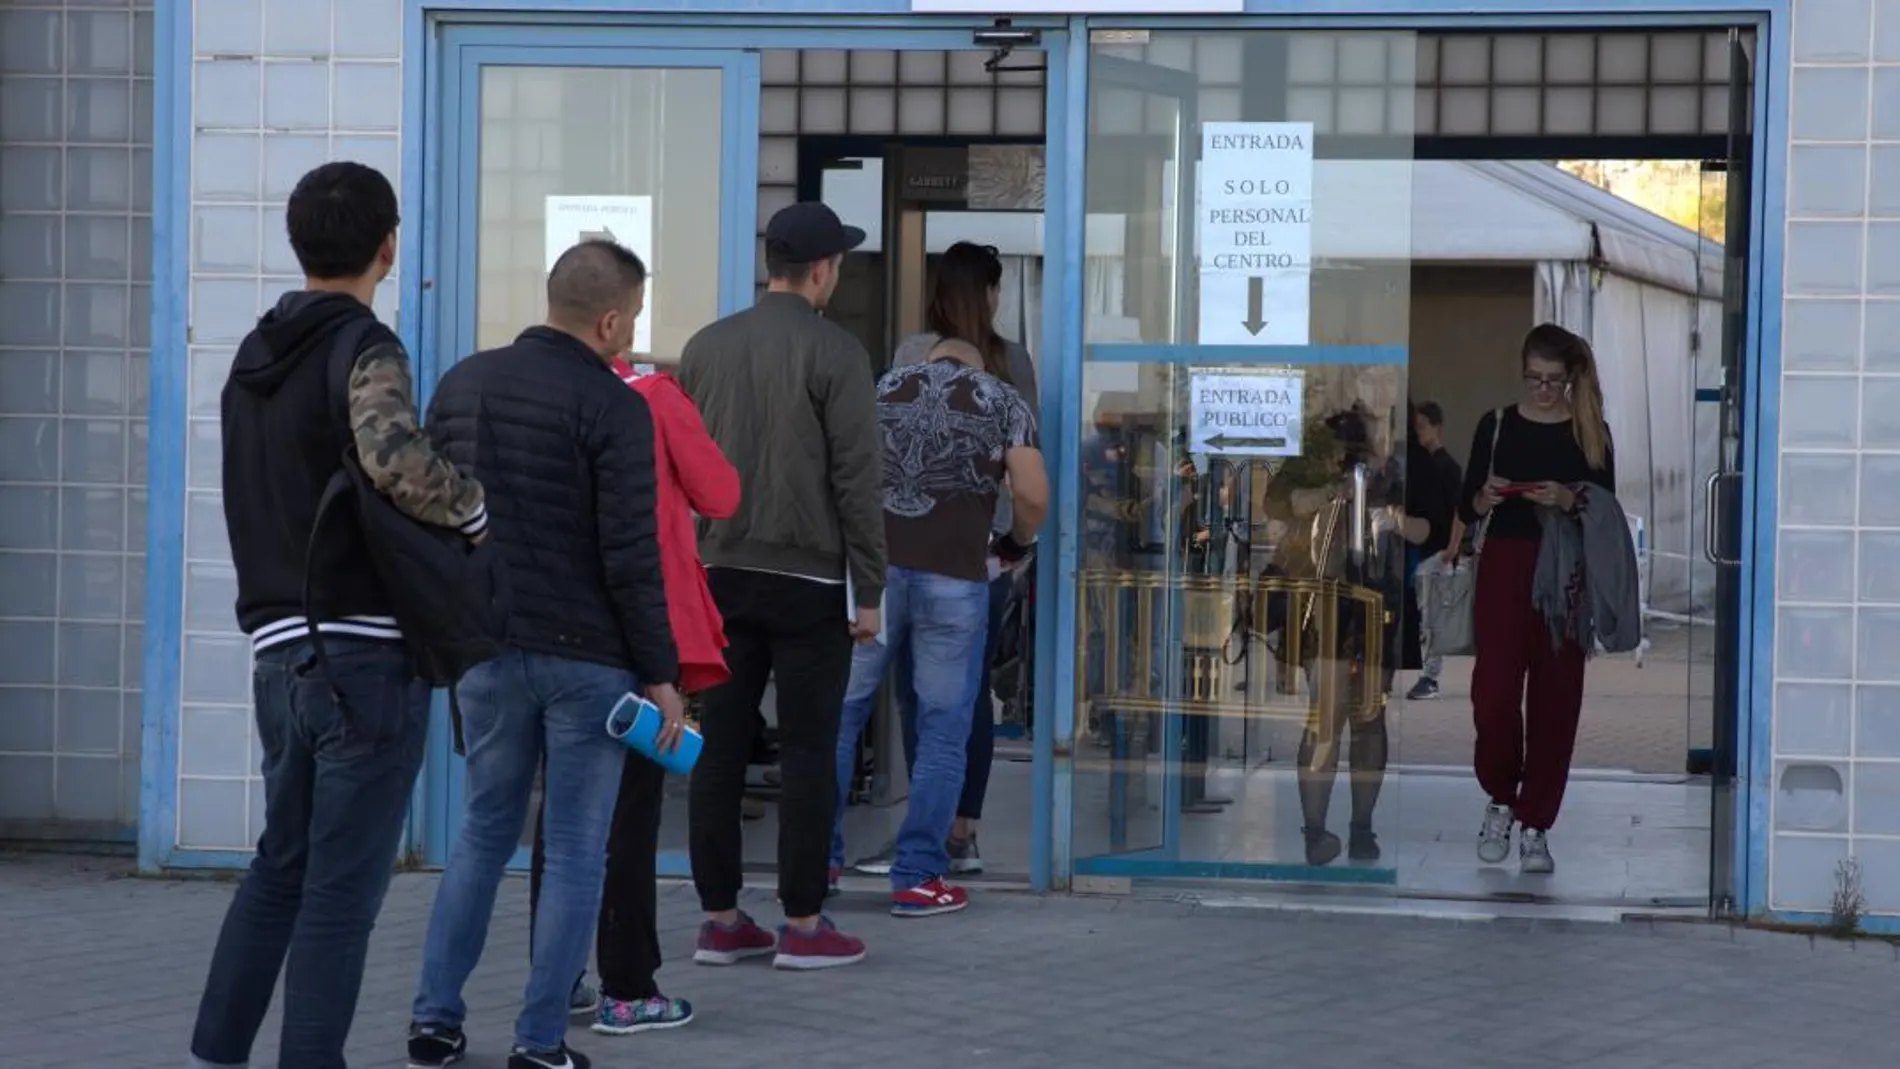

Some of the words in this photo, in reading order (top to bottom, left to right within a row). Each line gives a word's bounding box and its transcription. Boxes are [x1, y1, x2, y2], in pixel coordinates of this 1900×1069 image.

[1211, 134, 1304, 150] ENTRADA
[1209, 208, 1311, 224] PERSONAL
[1234, 231, 1272, 247] DEL
[1213, 253, 1293, 269] CENTRO
[1200, 389, 1292, 405] ENTRADA
[1203, 411, 1288, 427] PUBLICO
